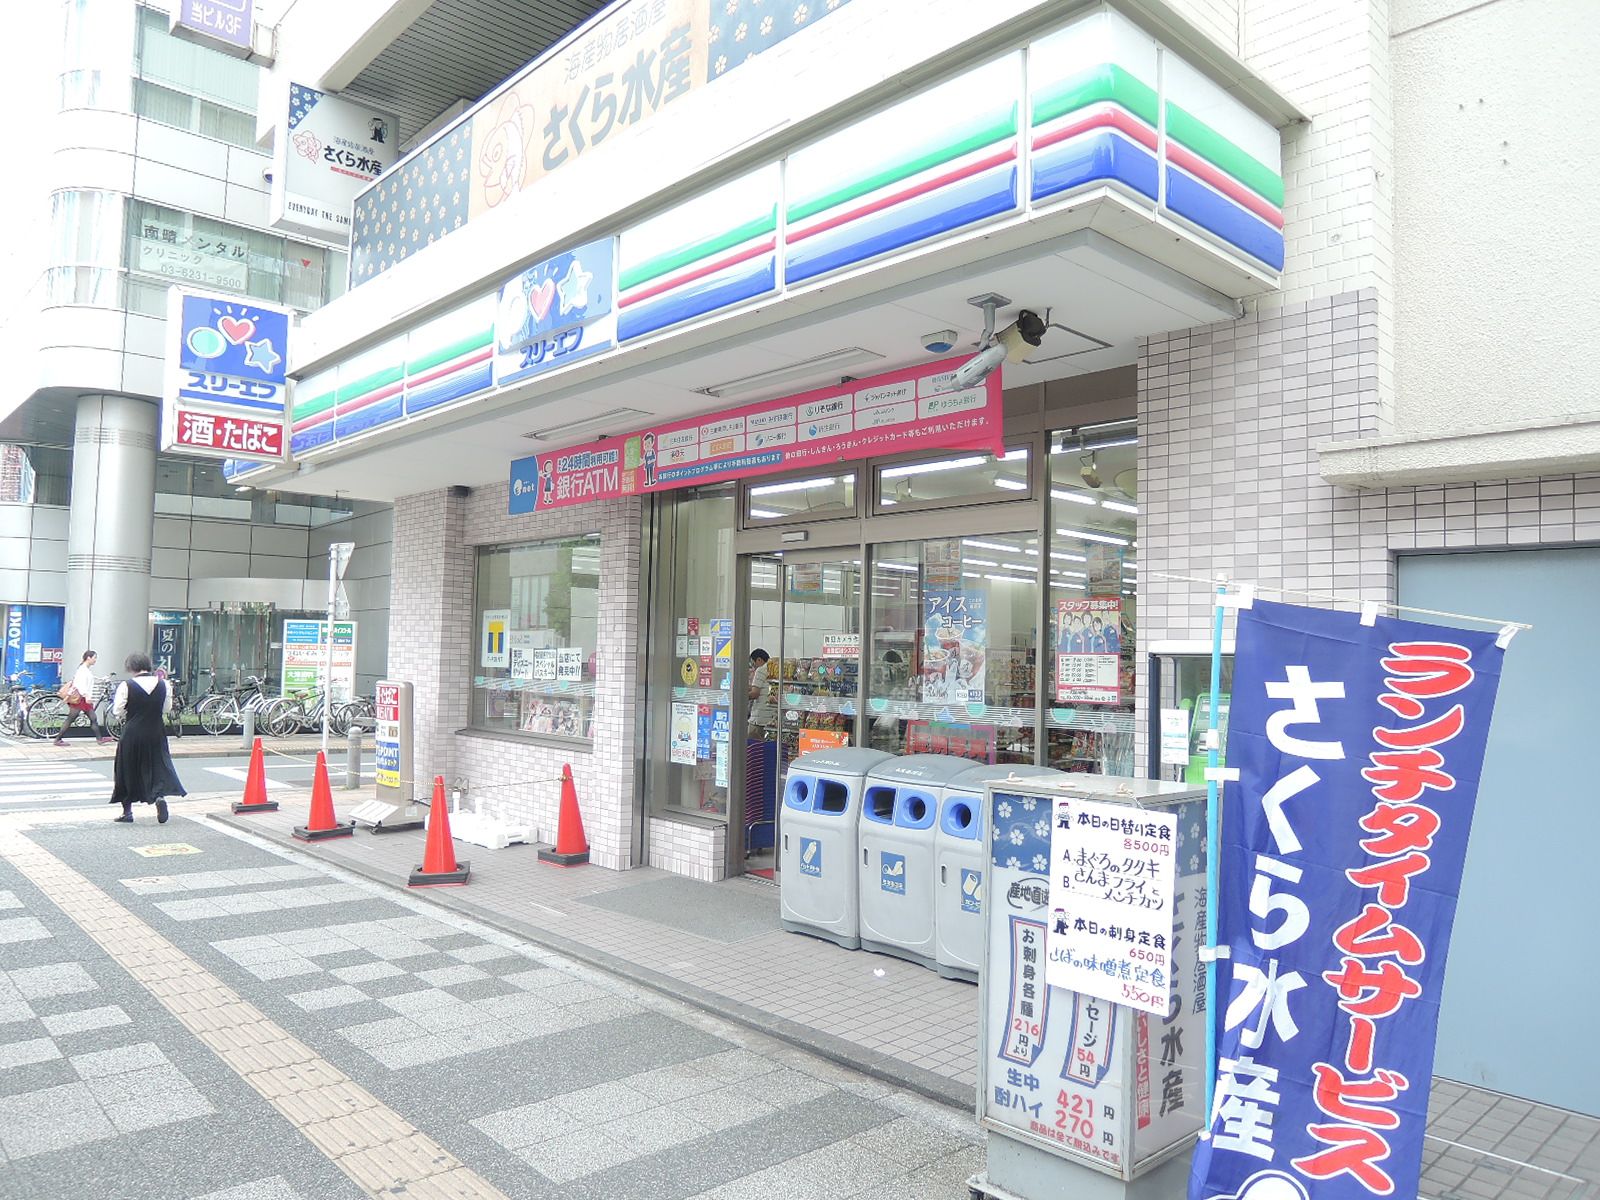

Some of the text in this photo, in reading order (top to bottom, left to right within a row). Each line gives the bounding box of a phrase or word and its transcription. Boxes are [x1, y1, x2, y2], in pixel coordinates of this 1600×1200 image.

[191, 1, 243, 36] 当ビル3F
[564, 0, 666, 84] 海産物居酒屋
[542, 23, 693, 172] さくら水産
[324, 145, 383, 176] さくら水産
[322, 210, 333, 221] THE
[519, 326, 584, 368] スリーエフ
[188, 372, 277, 398] スリーエフ
[182, 413, 278, 453] 酒・たばこ
[557, 467, 618, 499] 銀行ATM
[928, 596, 967, 613] アイス
[1060, 600, 1119, 611] スタッフ募集中!
[9, 611, 22, 650] AOKI
[942, 615, 983, 628] コーヒー
[558, 653, 581, 663] 当店にて
[1077, 812, 1171, 841] 本日の日替り定食
[1123, 838, 1170, 857] 各500円
[1210, 665, 1346, 1162] さくら水産
[1291, 641, 1475, 1196] ランチタイムサービス
[1074, 917, 1166, 950] 本日の刺身定食
[1020, 927, 1037, 1018] お刺身各種
[1129, 948, 1165, 966] 650円
[1121, 984, 1164, 1007] 550円
[1014, 1018, 1040, 1037] 216
[1083, 998, 1100, 1048] セージ
[1013, 1044, 1028, 1057] より
[1018, 1034, 1029, 1047] 円
[1077, 1048, 1096, 1065] 54
[1079, 1063, 1091, 1078] 円
[1007, 1067, 1041, 1092] 生中
[994, 1086, 1044, 1119] 酎ハイ
[1057, 1088, 1115, 1120] 421 円
[1030, 1120, 1120, 1162] 商品は全て税込みです
[1055, 1109, 1114, 1146] 270 円
